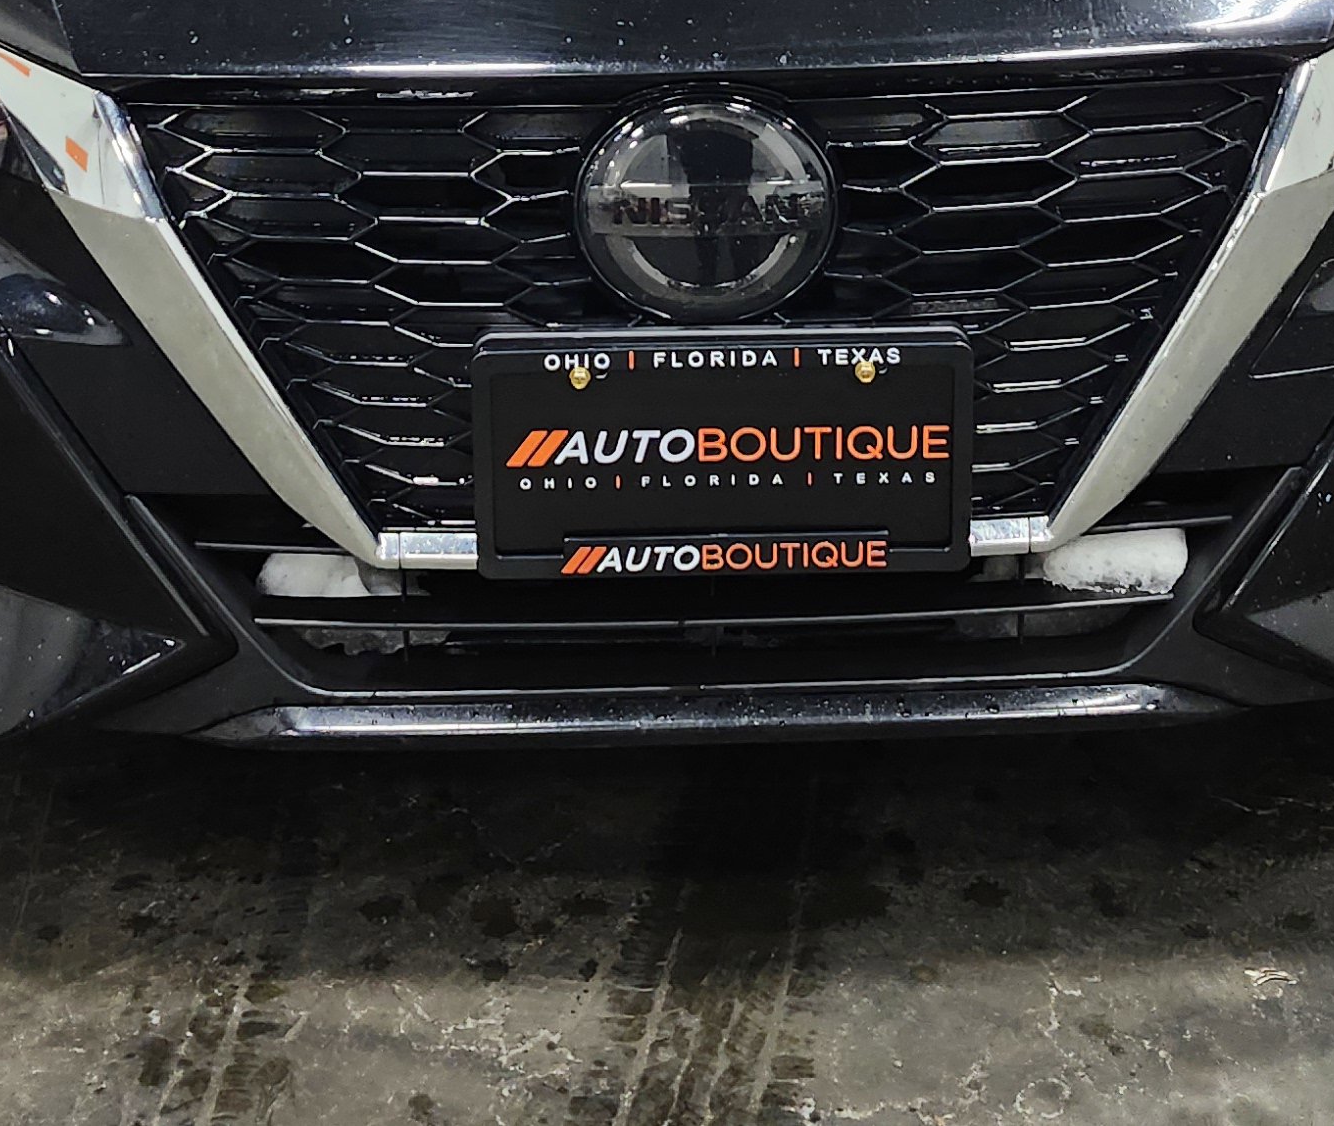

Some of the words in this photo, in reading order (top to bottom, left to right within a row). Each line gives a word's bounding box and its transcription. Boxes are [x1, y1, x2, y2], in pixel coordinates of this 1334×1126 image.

[612, 196, 800, 226] NISAN
[544, 352, 611, 372] OHIO
[653, 349, 778, 368] FLORIDA
[817, 347, 901, 366] TEXAS
[555, 425, 950, 465] AUTOBOUTIQUE
[519, 477, 598, 490] OHIO
[641, 473, 784, 487] FLORIDA
[833, 471, 937, 485] TEXAS
[597, 540, 888, 574] AUTOBOUTIQUE
